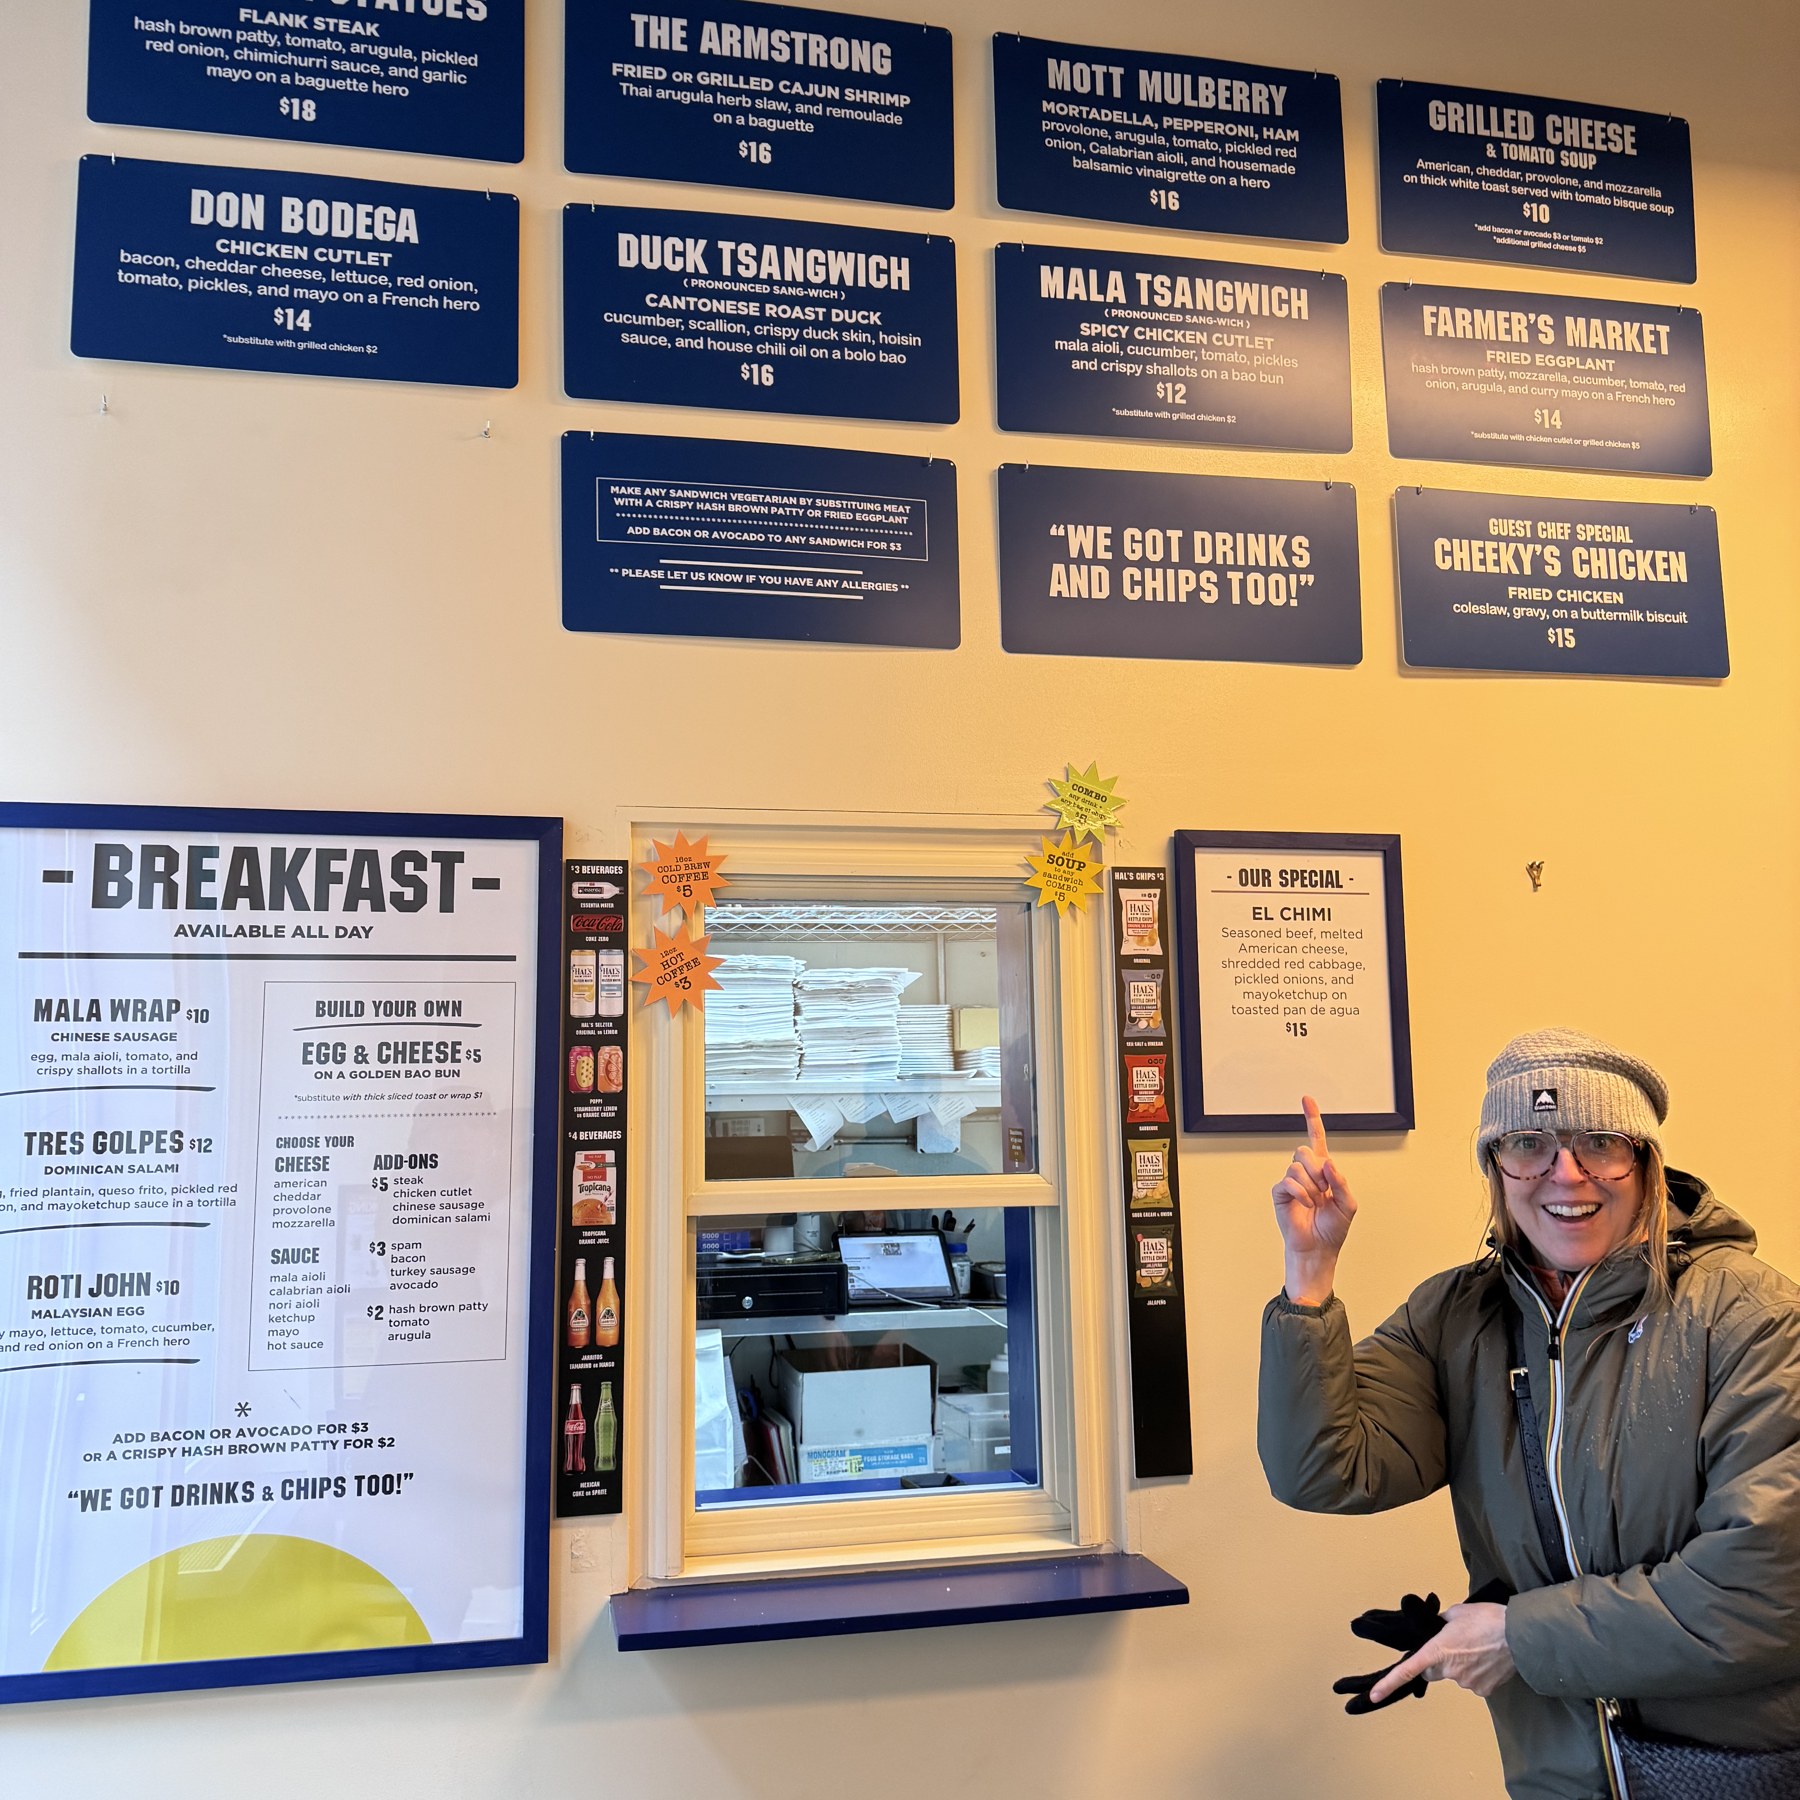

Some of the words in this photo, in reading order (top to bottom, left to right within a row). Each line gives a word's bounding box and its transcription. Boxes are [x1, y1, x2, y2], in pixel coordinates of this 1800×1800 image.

[239, 8, 308, 29] FLANK
[313, 16, 379, 37] STEAK
[631, 13, 687, 51] THE
[700, 21, 891, 75] ARMSTRONG
[612, 62, 666, 80] FRIED
[672, 71, 692, 83] OR
[696, 71, 773, 91] GRILLED
[778, 80, 839, 99] CAJUN
[844, 88, 910, 107] SHRIMP
[1047, 57, 1124, 98] MOTT
[1138, 69, 1286, 115] MULBERRY
[280, 96, 315, 121] $18
[1042, 100, 1158, 129] MORTADELLA,
[1163, 116, 1258, 140] PEPPERONI,
[1263, 127, 1299, 141] HAM
[1429, 100, 1534, 141] GRILLED
[1546, 114, 1637, 155] CHEESE
[738, 140, 771, 163] $16
[1486, 143, 1496, 157] &
[1501, 142, 1554, 164] TOMATO
[1560, 150, 1596, 170] SOUP
[1150, 188, 1179, 210] $16
[190, 188, 264, 230] DON
[281, 196, 418, 243] BODEGA
[1523, 201, 1549, 223] $10
[216, 239, 307, 260] CHICKEN
[314, 247, 392, 266] CUTLET
[618, 232, 708, 274] DUCK
[717, 240, 909, 290] TSANGWICH
[1040, 265, 1126, 303] MALA
[1135, 272, 1310, 320] TSANGWICH
[273, 307, 311, 331] $14
[645, 293, 759, 316] CANTONESE
[765, 303, 826, 320] ROAST
[831, 308, 881, 325] DUCK
[1080, 322, 1129, 338] SPICY
[1134, 326, 1207, 344] CHICKEN
[1212, 333, 1274, 349] CUTLET
[1423, 305, 1554, 344] FARMER'S
[1565, 316, 1669, 354] MARKET
[275, 339, 295, 347] with
[297, 341, 326, 350] grilled
[328, 343, 364, 352] chicken
[366, 344, 377, 354] $2
[1486, 350, 1531, 364] FRIED
[1535, 353, 1615, 371] EGGPLANT
[741, 362, 773, 386] $16
[1156, 381, 1186, 404] $12
[1534, 408, 1562, 429] $14
[627, 526, 650, 534] ADD
[653, 527, 690, 537] BACON
[693, 529, 709, 538] OR
[711, 531, 765, 541] AVOCADO
[767, 534, 781, 542] TO
[784, 535, 806, 543] ANY
[809, 537, 864, 547] SANDWICH
[866, 540, 887, 549] FOR
[889, 542, 901, 551] $3
[1489, 518, 1532, 537] GUEST
[1537, 521, 1571, 539] CHEF
[1576, 523, 1633, 543] SPECIAL
[1050, 524, 1112, 559] "WE
[1123, 527, 1182, 562] GOT
[1193, 530, 1310, 567] DRINKS
[1434, 537, 1561, 576] CHEEKY'S
[1572, 546, 1687, 582] CHICKEN
[1049, 563, 1109, 598] AND
[1122, 567, 1218, 603] CHIPS
[1227, 571, 1314, 606] TOO!"
[1508, 586, 1552, 600] FRIED
[1556, 589, 1623, 604] CHICKEN
[1547, 627, 1575, 647] $15
[1071, 784, 1107, 802] COMBO
[571, 866, 580, 874] $3
[582, 866, 623, 874] BEVERAGES
[657, 865, 682, 873] COLD
[685, 862, 711, 870] BREW
[1047, 854, 1086, 872] SOUP
[91, 843, 465, 913] BREAKFAST
[662, 872, 709, 884] COFFEE
[1043, 872, 1084, 886] sandwich
[1046, 880, 1078, 893] COMBO
[1114, 872, 1134, 880] HAL'S
[1136, 872, 1155, 880] CHIPS
[1238, 868, 1271, 887] OUR
[1278, 869, 1343, 888] SPECIAL
[677, 885, 693, 897] $5
[1055, 892, 1065, 902] $5
[1252, 906, 1273, 920] EL
[1280, 907, 1331, 921] CHIMI
[174, 924, 285, 937] AVAILABLE
[291, 925, 329, 938] ALL
[335, 925, 373, 938] DAY
[656, 957, 701, 986] COFFEE
[660, 952, 685, 971] HOT
[674, 976, 692, 990] $3
[1133, 985, 1154, 994] HAL'S
[33, 998, 101, 1022] MALA
[110, 998, 180, 1022] WRAP
[186, 1008, 209, 1023] $10
[315, 1000, 364, 1017] BUILD
[372, 1000, 416, 1017] YOUR
[424, 1000, 461, 1016] OWN
[1231, 1004, 1278, 1015] toasted
[1283, 1006, 1306, 1016] pan
[1310, 1004, 1325, 1015] de
[1329, 1006, 1359, 1017] agua
[1285, 1021, 1307, 1036] $15
[302, 1042, 346, 1065] EGG
[353, 1045, 369, 1064] &
[377, 1041, 461, 1064] CHEESE
[465, 1049, 481, 1063] $5
[1136, 1070, 1156, 1079] HAL'S
[24, 1131, 84, 1155] TRES
[92, 1130, 183, 1154] GOLPES
[189, 1138, 212, 1153] $12
[568, 1132, 577, 1140] $4
[580, 1131, 621, 1140] BEVERAGES
[274, 1155, 329, 1172] CHEESE
[373, 1153, 438, 1170] ADD-ONS
[1139, 1154, 1160, 1165] HAL'S
[578, 1182, 611, 1193] Tropicana
[271, 1247, 319, 1264] SAUCE
[1143, 1241, 1164, 1251] HAL'S
[27, 1274, 81, 1299] ROTI
[88, 1272, 151, 1297] JOHN
[156, 1280, 179, 1295] $10
